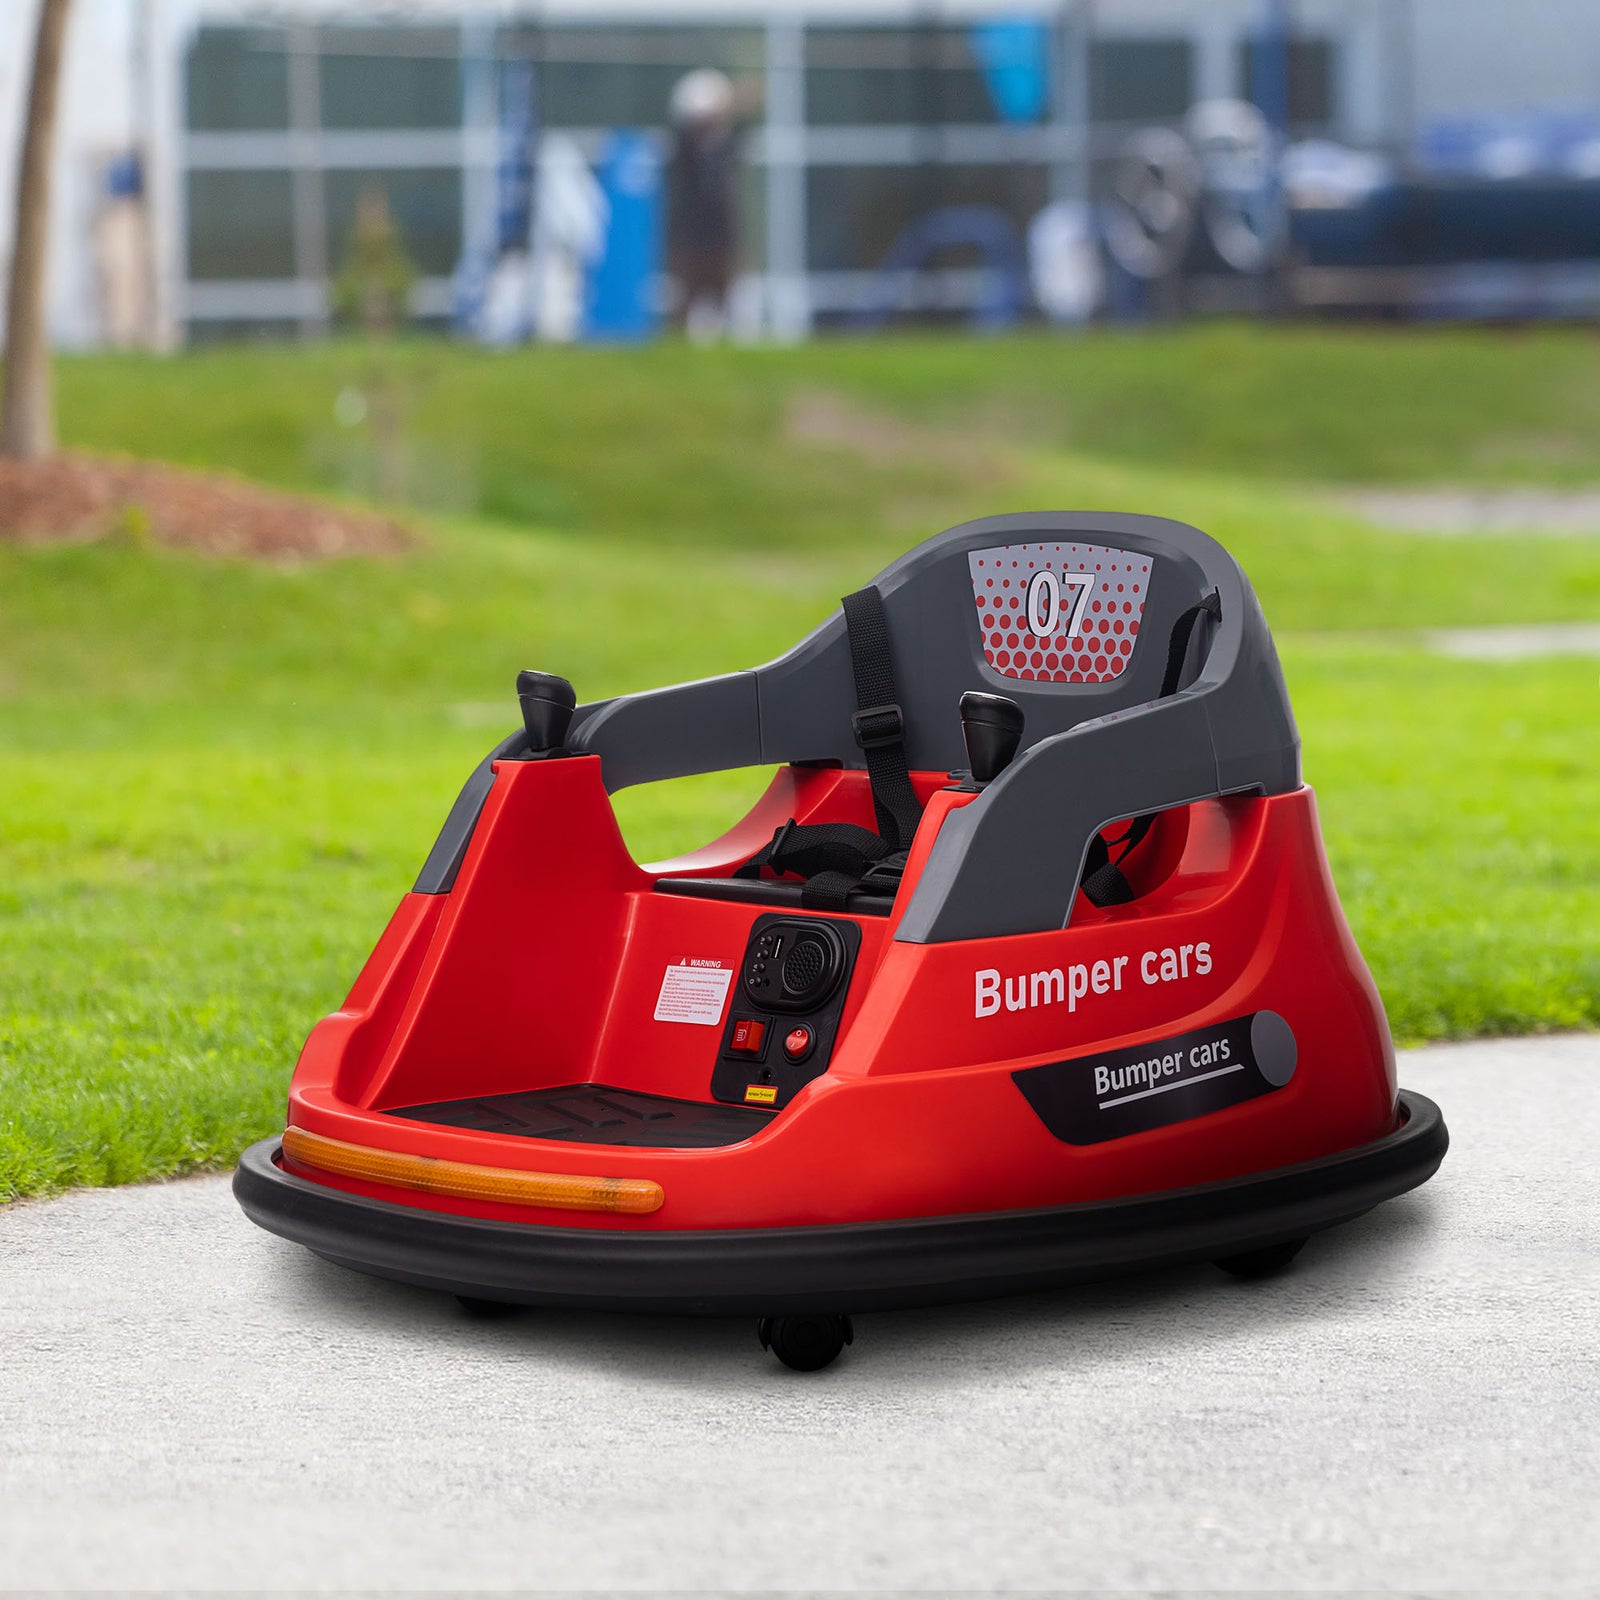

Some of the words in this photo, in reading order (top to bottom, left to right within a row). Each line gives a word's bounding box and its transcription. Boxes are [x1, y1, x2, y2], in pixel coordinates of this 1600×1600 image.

[1026, 570, 1096, 638] 07
[690, 958, 722, 968] WARNING
[974, 953, 1130, 1019] Bumper
[1140, 941, 1213, 985] cars
[1094, 1051, 1183, 1095] Bumper
[1188, 1037, 1231, 1069] cars
